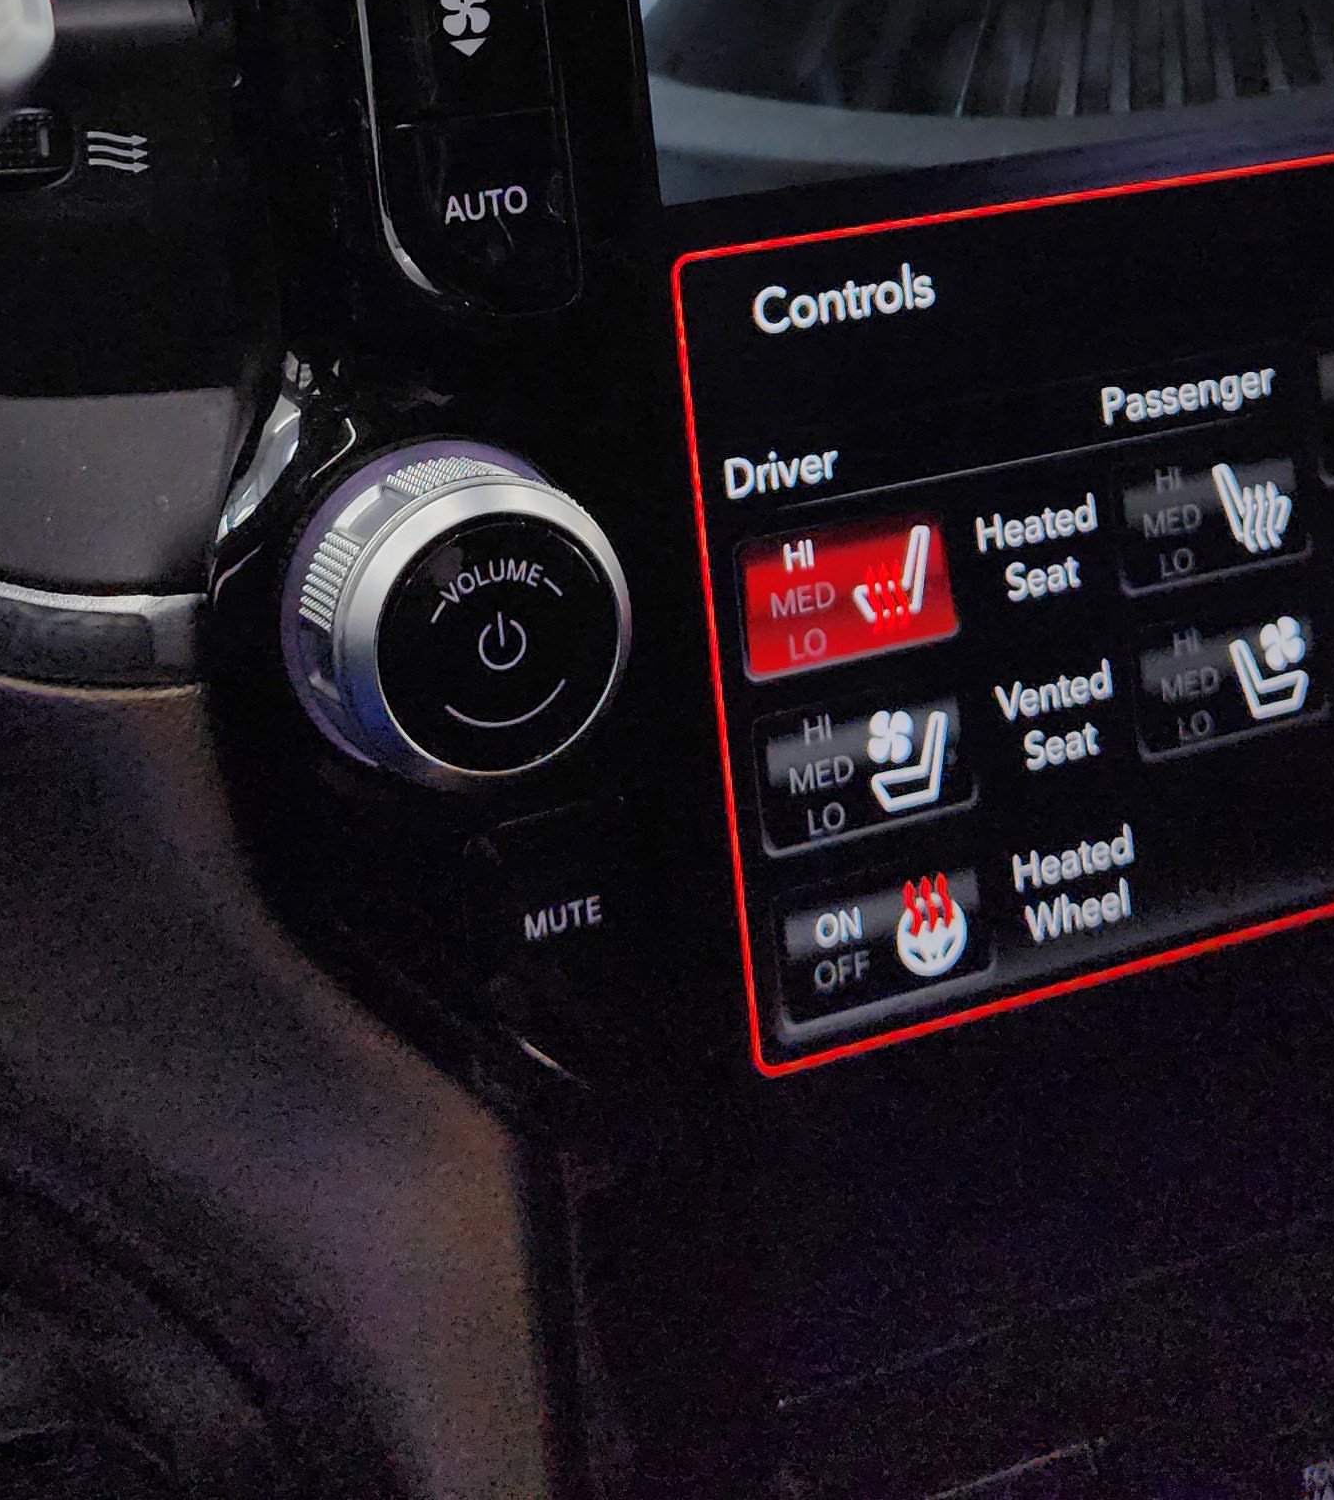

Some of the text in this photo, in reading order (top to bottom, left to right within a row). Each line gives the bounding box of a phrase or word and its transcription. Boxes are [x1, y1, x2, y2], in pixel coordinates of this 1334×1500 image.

[444, 185, 529, 226] AUTO
[752, 262, 937, 335] Controls
[1100, 367, 1277, 426] Passenger
[724, 446, 839, 500] Driver
[975, 492, 1099, 555] Heated
[1142, 502, 1203, 541] MED
[782, 537, 816, 573] HI
[1159, 546, 1197, 578] LO
[439, 558, 544, 606] VOLUME
[769, 580, 836, 619] MED
[1005, 555, 1081, 604] Seat
[787, 627, 828, 661] LO
[993, 659, 1114, 724] Vented
[1159, 668, 1221, 706] MED
[804, 713, 833, 743] HI
[1175, 708, 1216, 741] LO
[1023, 722, 1101, 772] Seat
[788, 755, 856, 796] MED
[806, 801, 847, 838] LO
[1011, 823, 1135, 893] Heated
[524, 895, 604, 941] MUTE
[813, 905, 863, 948] ON
[1023, 876, 1132, 943] Wheel
[813, 954, 870, 995] OFF
